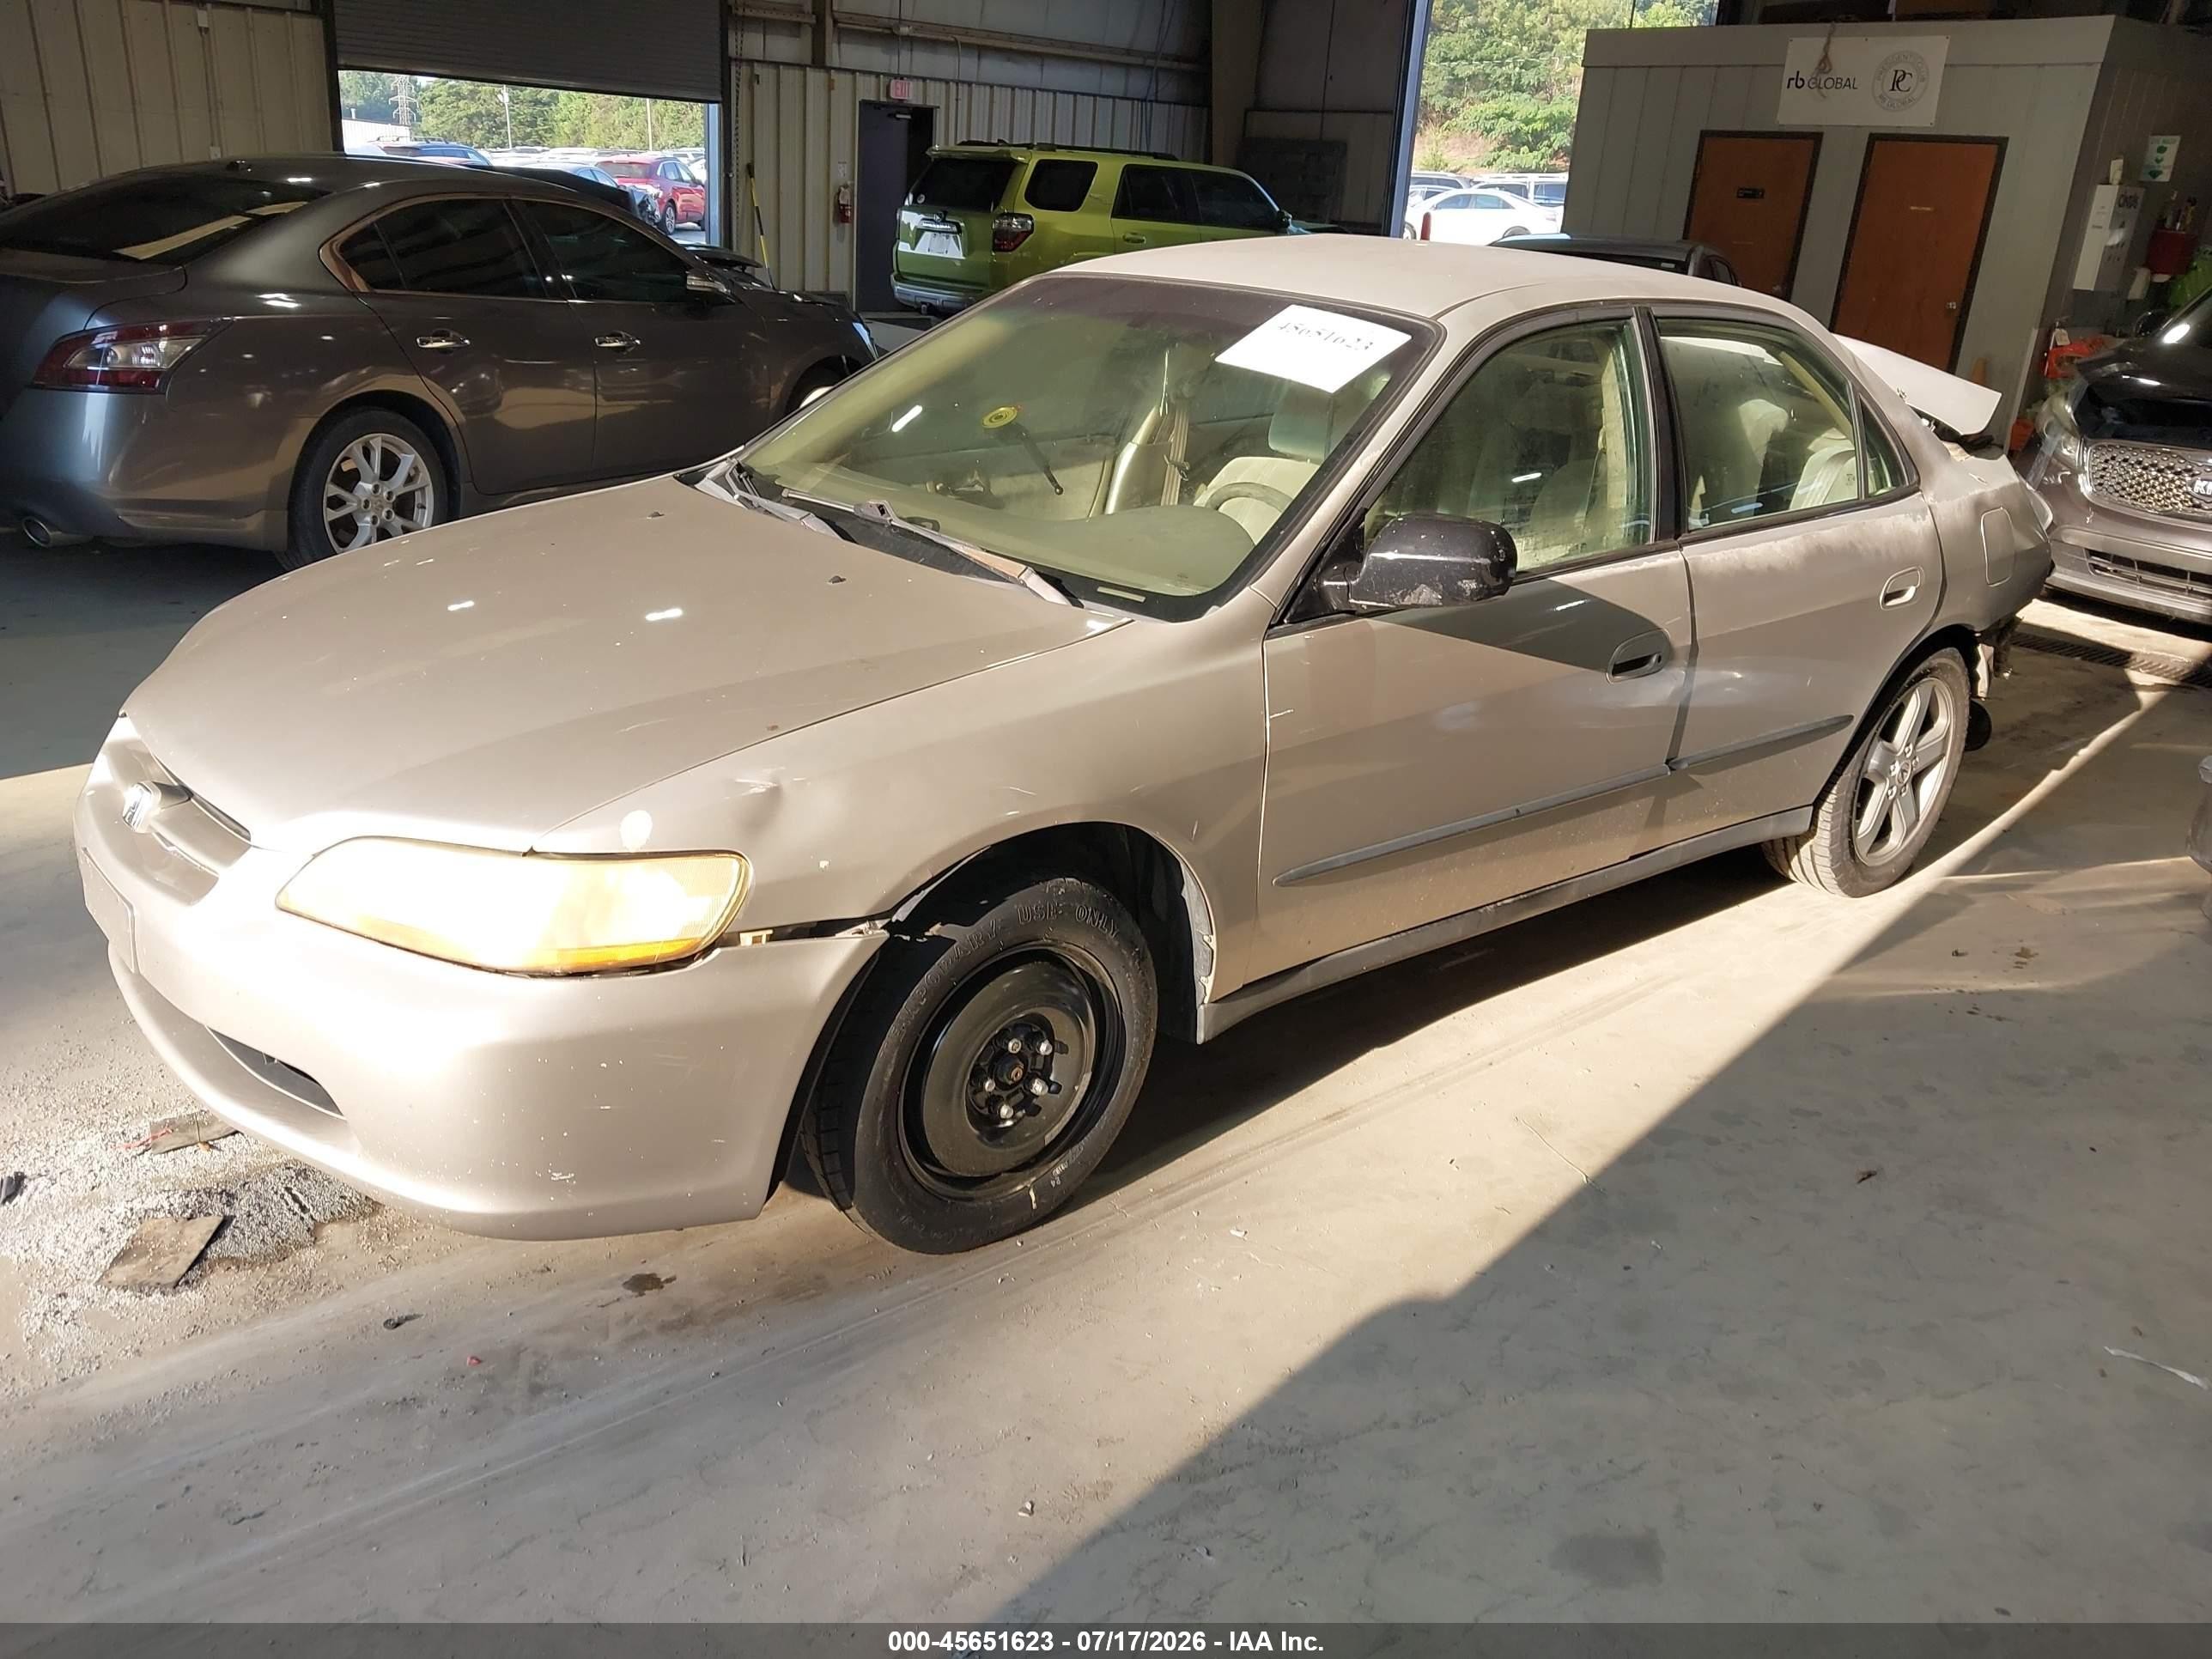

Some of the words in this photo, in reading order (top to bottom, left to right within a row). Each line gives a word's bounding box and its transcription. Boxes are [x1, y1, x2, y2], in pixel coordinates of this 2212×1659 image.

[1786, 70, 1805, 89] rb
[1807, 76, 1858, 90] GLOBAL
[1074, 904, 1120, 941] ONLY
